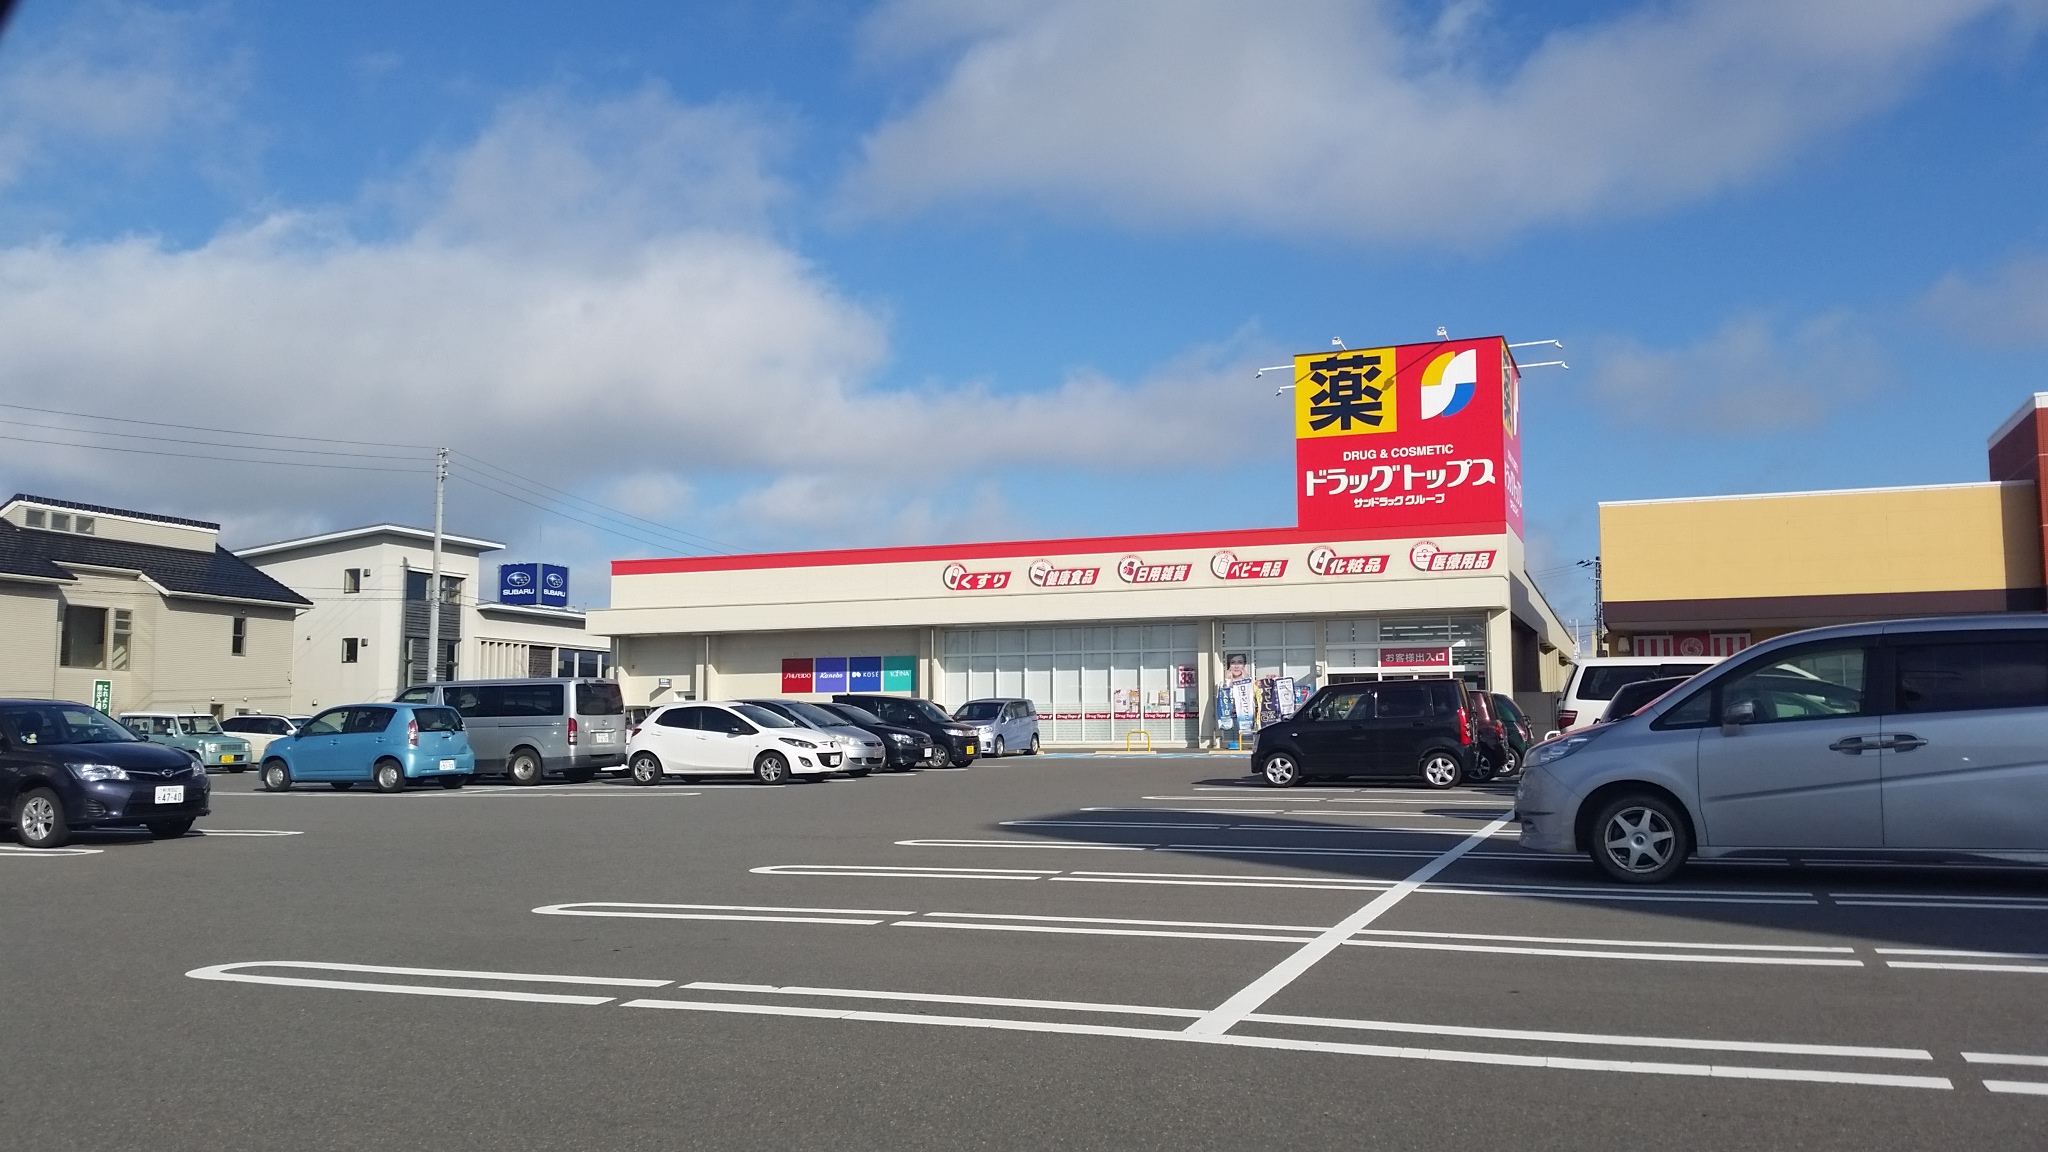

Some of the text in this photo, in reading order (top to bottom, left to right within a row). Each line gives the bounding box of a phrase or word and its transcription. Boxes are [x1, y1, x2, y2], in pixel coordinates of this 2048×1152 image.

[1309, 354, 1383, 431] 薬
[1343, 444, 1454, 462] DRUG & COSMETIC
[1306, 458, 1496, 497] ドラッグトップス
[1230, 561, 1282, 578] ベビー用品
[1329, 556, 1382, 574] 化粧品
[1430, 551, 1489, 570] 医療用品
[959, 574, 1005, 589] くすり
[1046, 568, 1094, 586] 健康食品
[1136, 564, 1188, 582] 日用雑貨
[502, 588, 535, 596] SUBARU
[543, 588, 566, 598] SUBARU
[1385, 652, 1445, 663] お客様出入口
[819, 671, 844, 679] Kanebo
